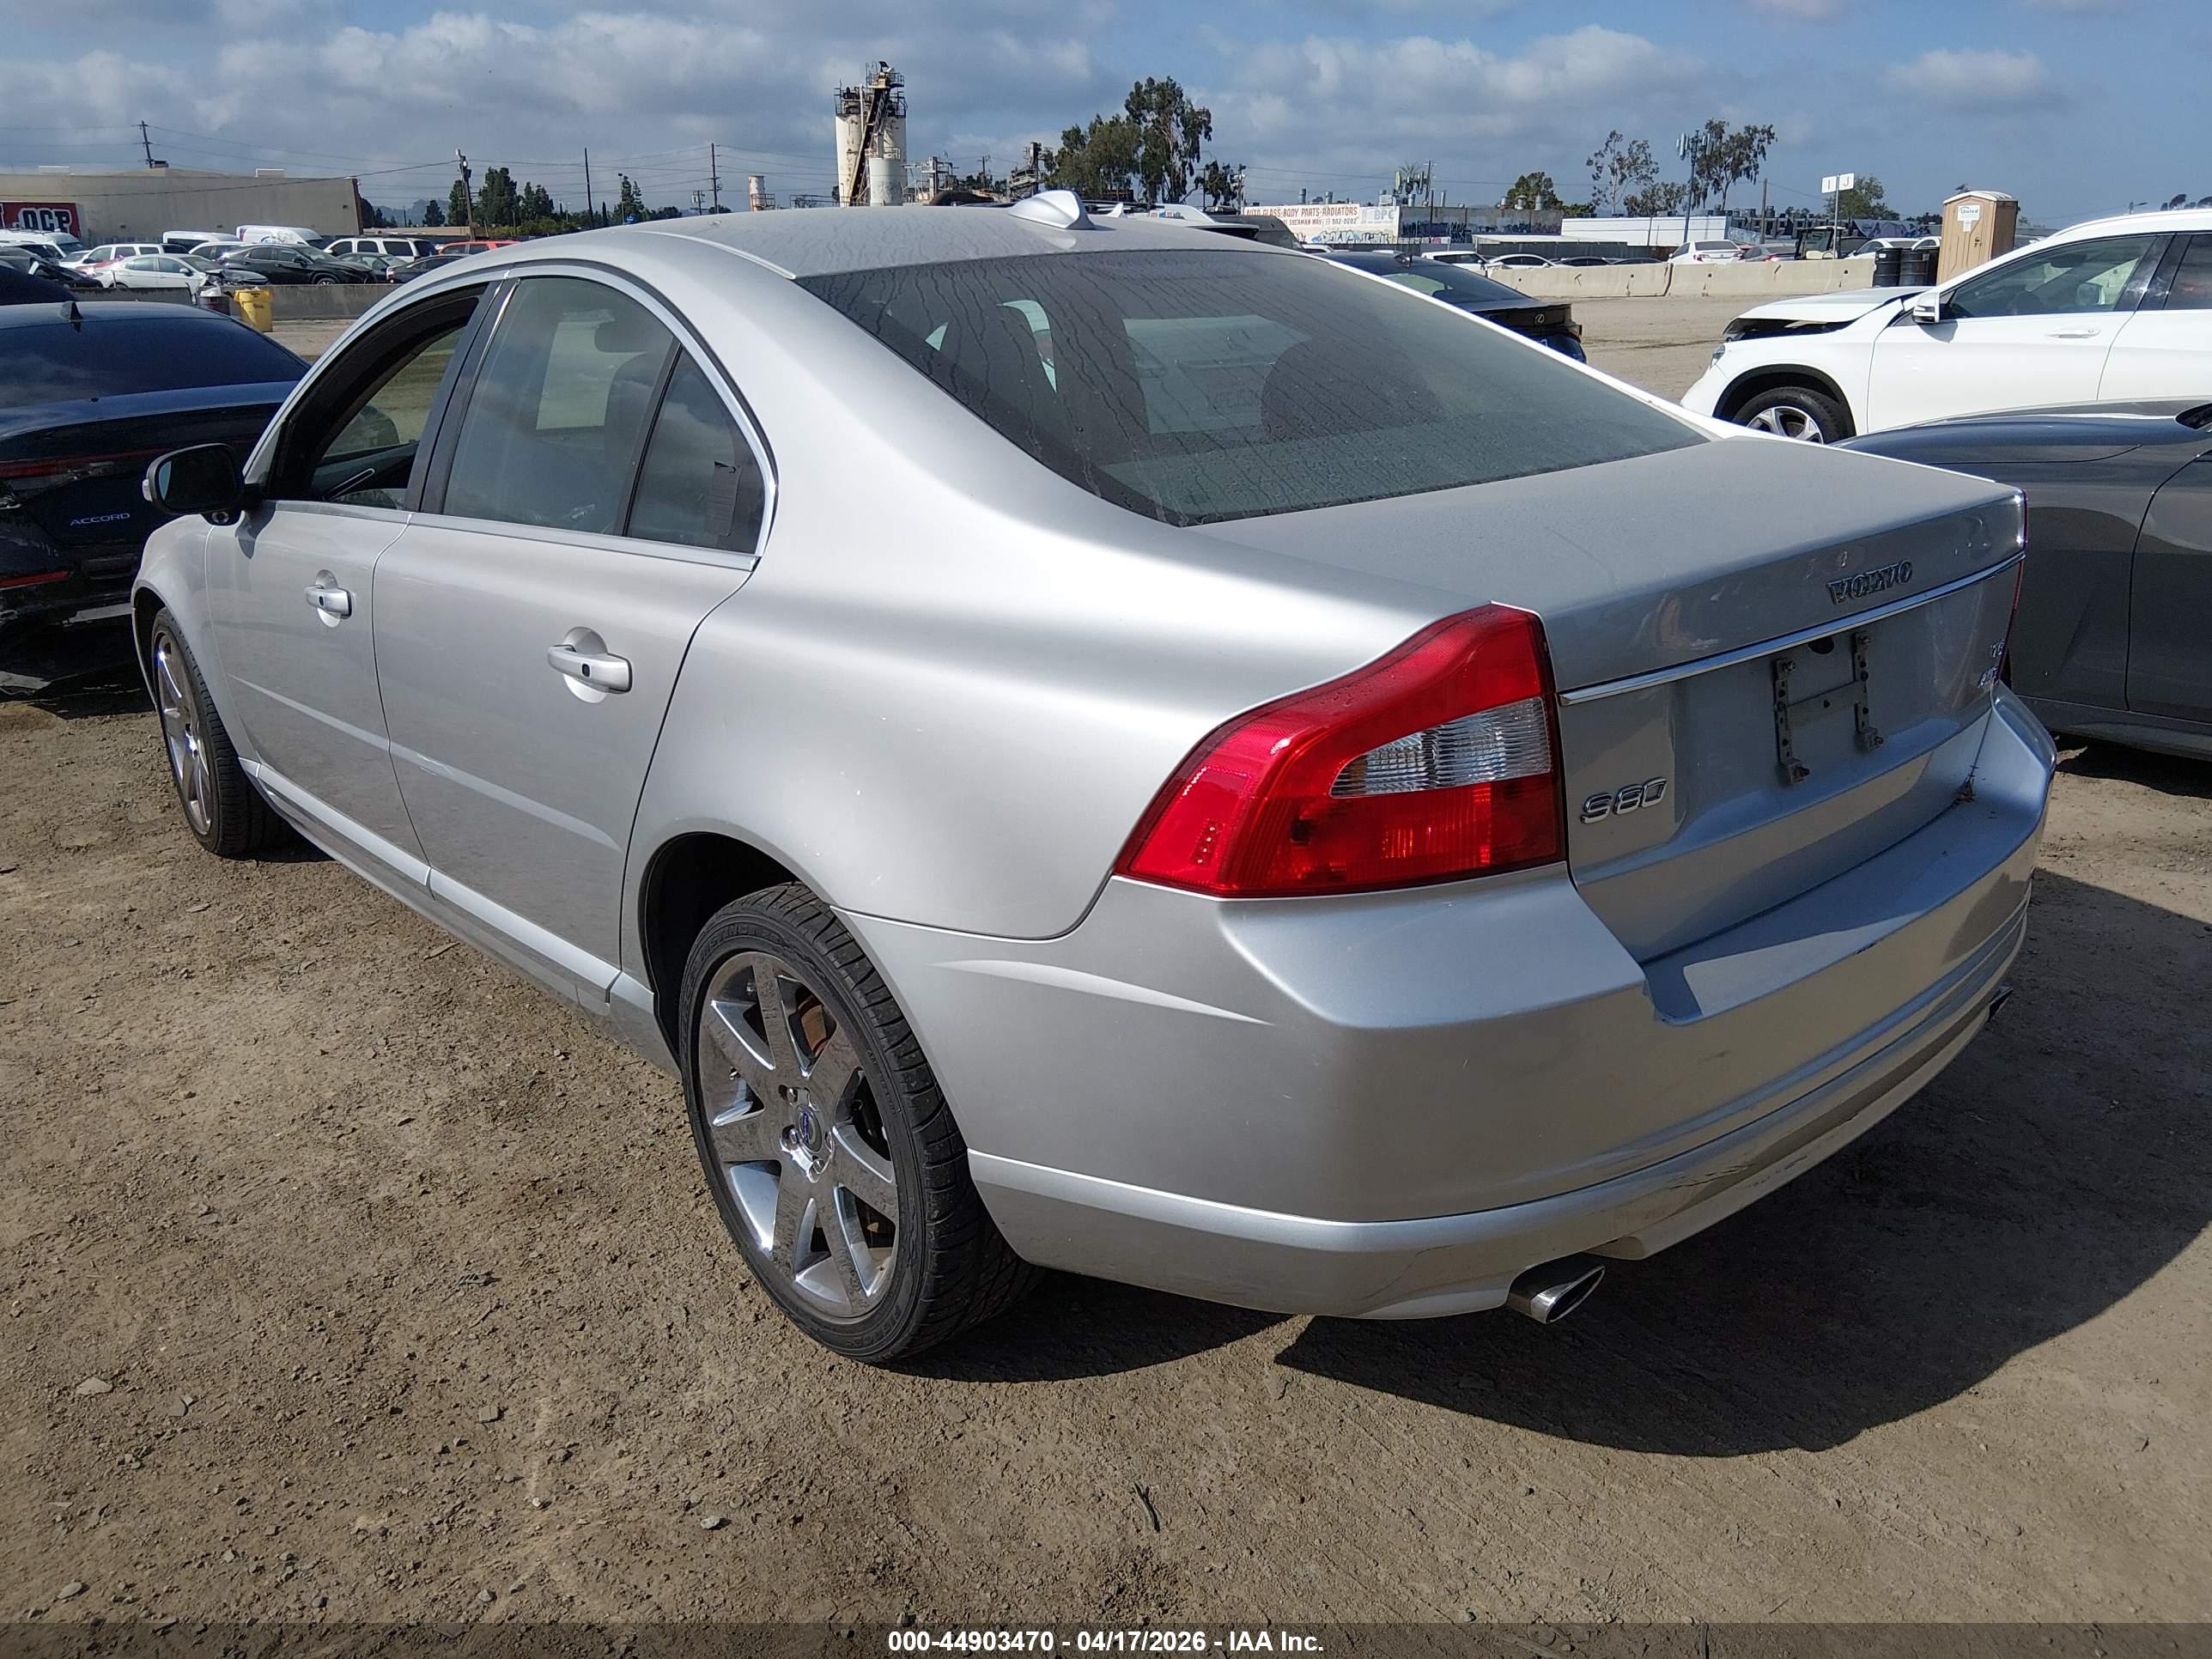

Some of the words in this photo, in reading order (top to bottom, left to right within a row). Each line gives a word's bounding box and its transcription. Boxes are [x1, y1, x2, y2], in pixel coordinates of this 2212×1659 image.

[70, 513, 131, 526] ACCORD
[1826, 560, 1913, 605] VOLVO
[1580, 776, 1668, 824] S80
